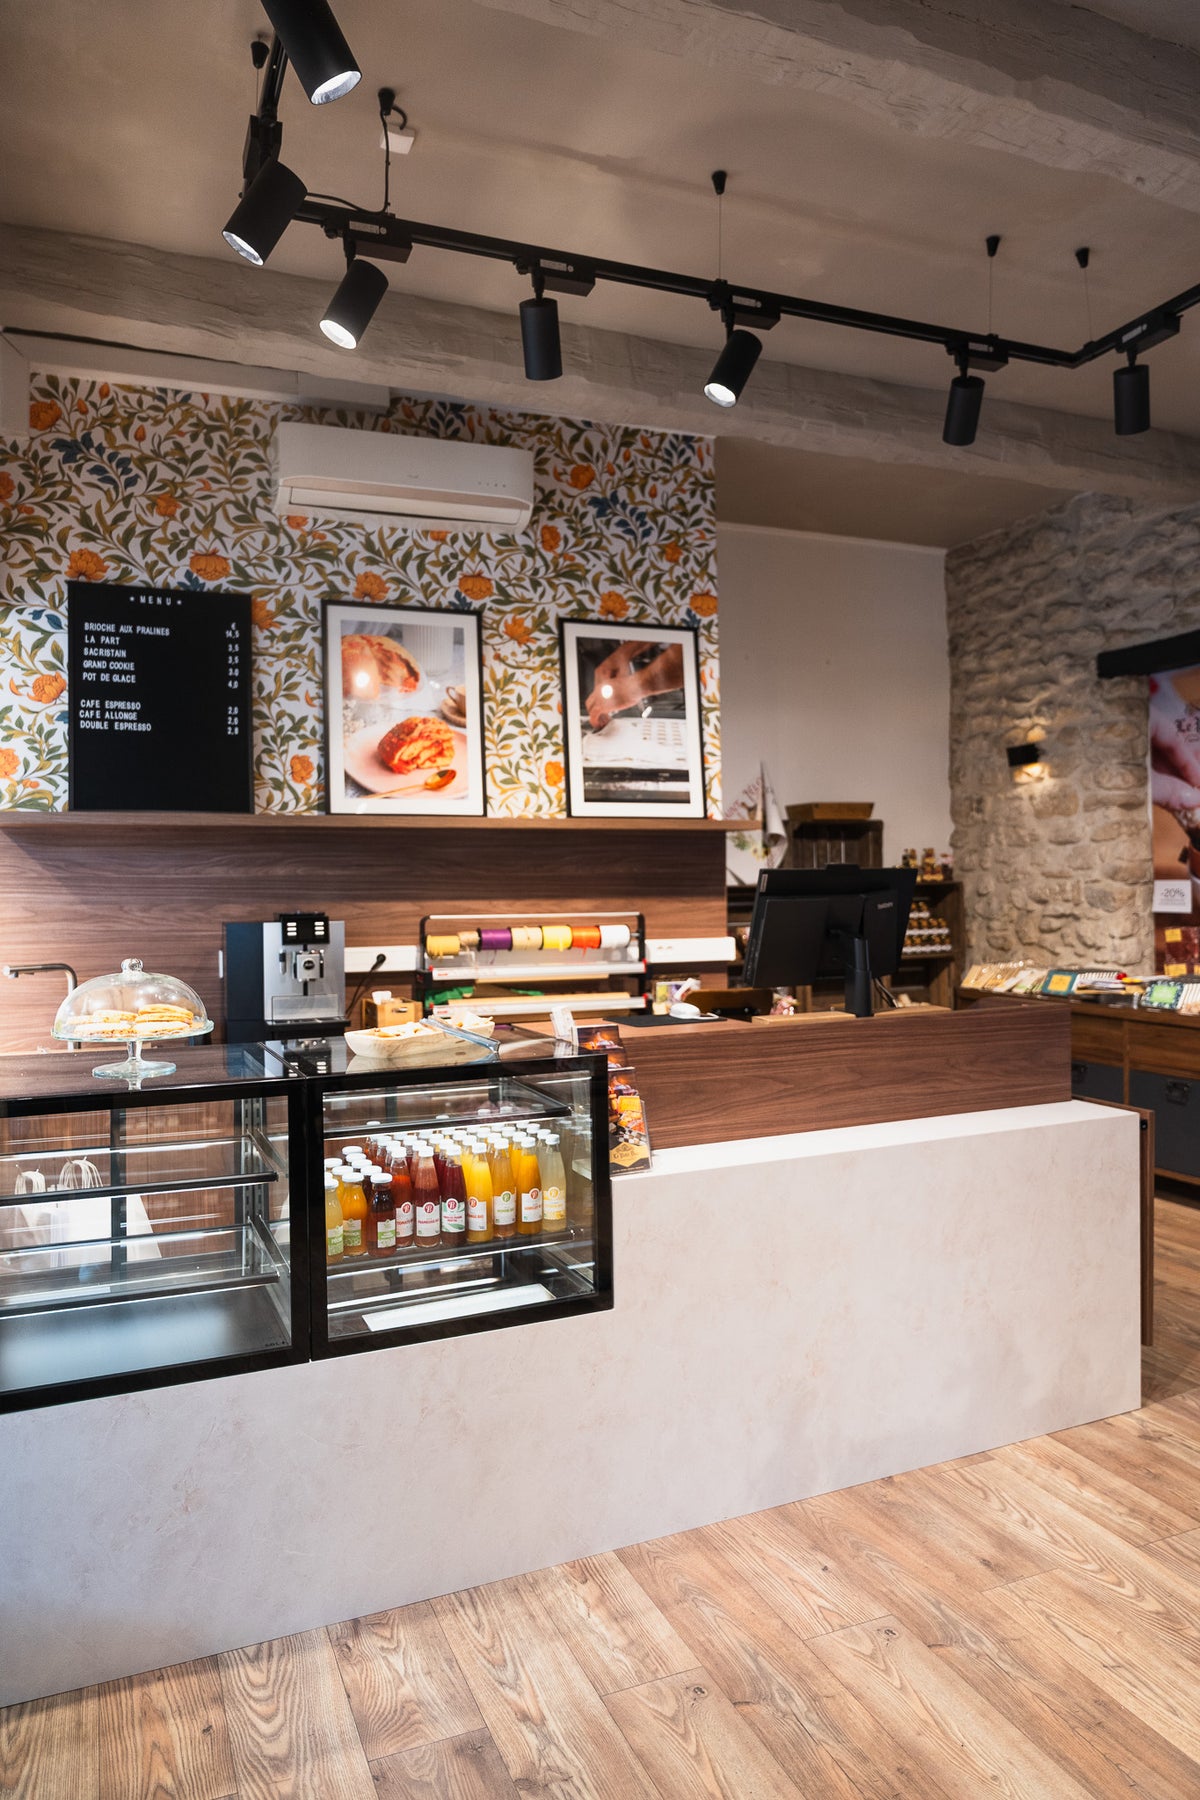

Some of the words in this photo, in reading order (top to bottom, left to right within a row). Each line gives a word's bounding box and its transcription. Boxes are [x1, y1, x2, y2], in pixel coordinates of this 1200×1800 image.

[140, 595, 172, 606] MENU
[84, 622, 116, 632] BRIOCHE
[119, 624, 133, 633] AUX
[136, 626, 170, 636] PRALINES
[85, 634, 96, 643] LA
[100, 635, 120, 645] PART
[83, 647, 127, 658] SACRISTAIN
[83, 659, 107, 669] GRAND
[109, 661, 135, 671] COOKIE
[82, 672, 97, 681] POT
[100, 673, 110, 682] DE
[112, 674, 136, 683] GLACE
[80, 699, 101, 708] CAFE
[105, 700, 141, 710] ESPRESSO
[79, 710, 101, 719] CAFE
[105, 711, 138, 720] ALLONGE
[80, 720, 109, 729] DOUBLE
[114, 722, 152, 731] ESPRESSO
